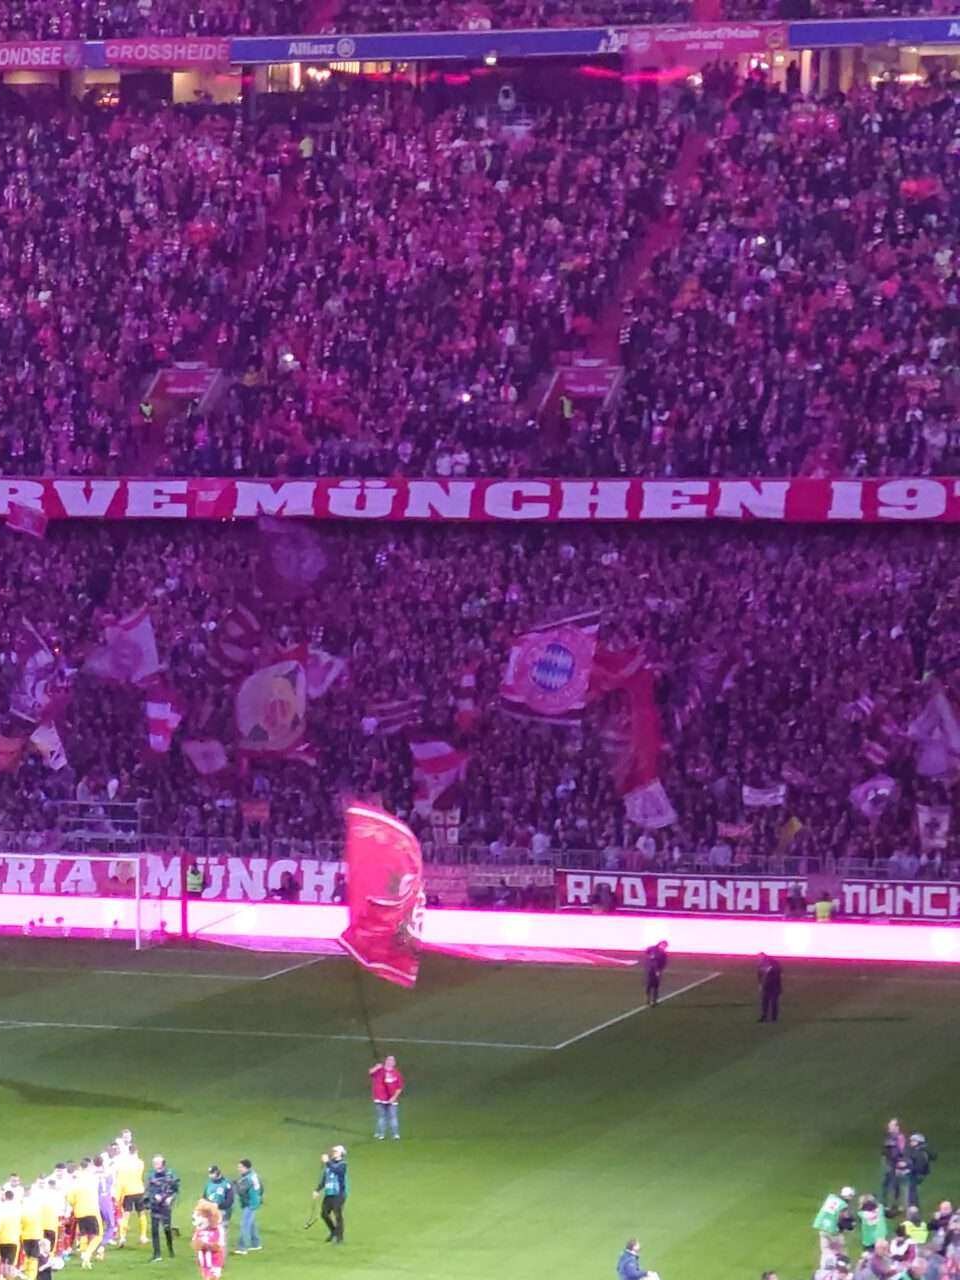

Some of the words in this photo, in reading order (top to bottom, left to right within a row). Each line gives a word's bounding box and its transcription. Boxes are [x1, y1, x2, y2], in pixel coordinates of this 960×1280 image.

[106, 42, 229, 62] GROSSHEIDE
[287, 41, 336, 56] Allianz
[232, 478, 788, 519] MÜNCHEN
[827, 478, 960, 520] 19
